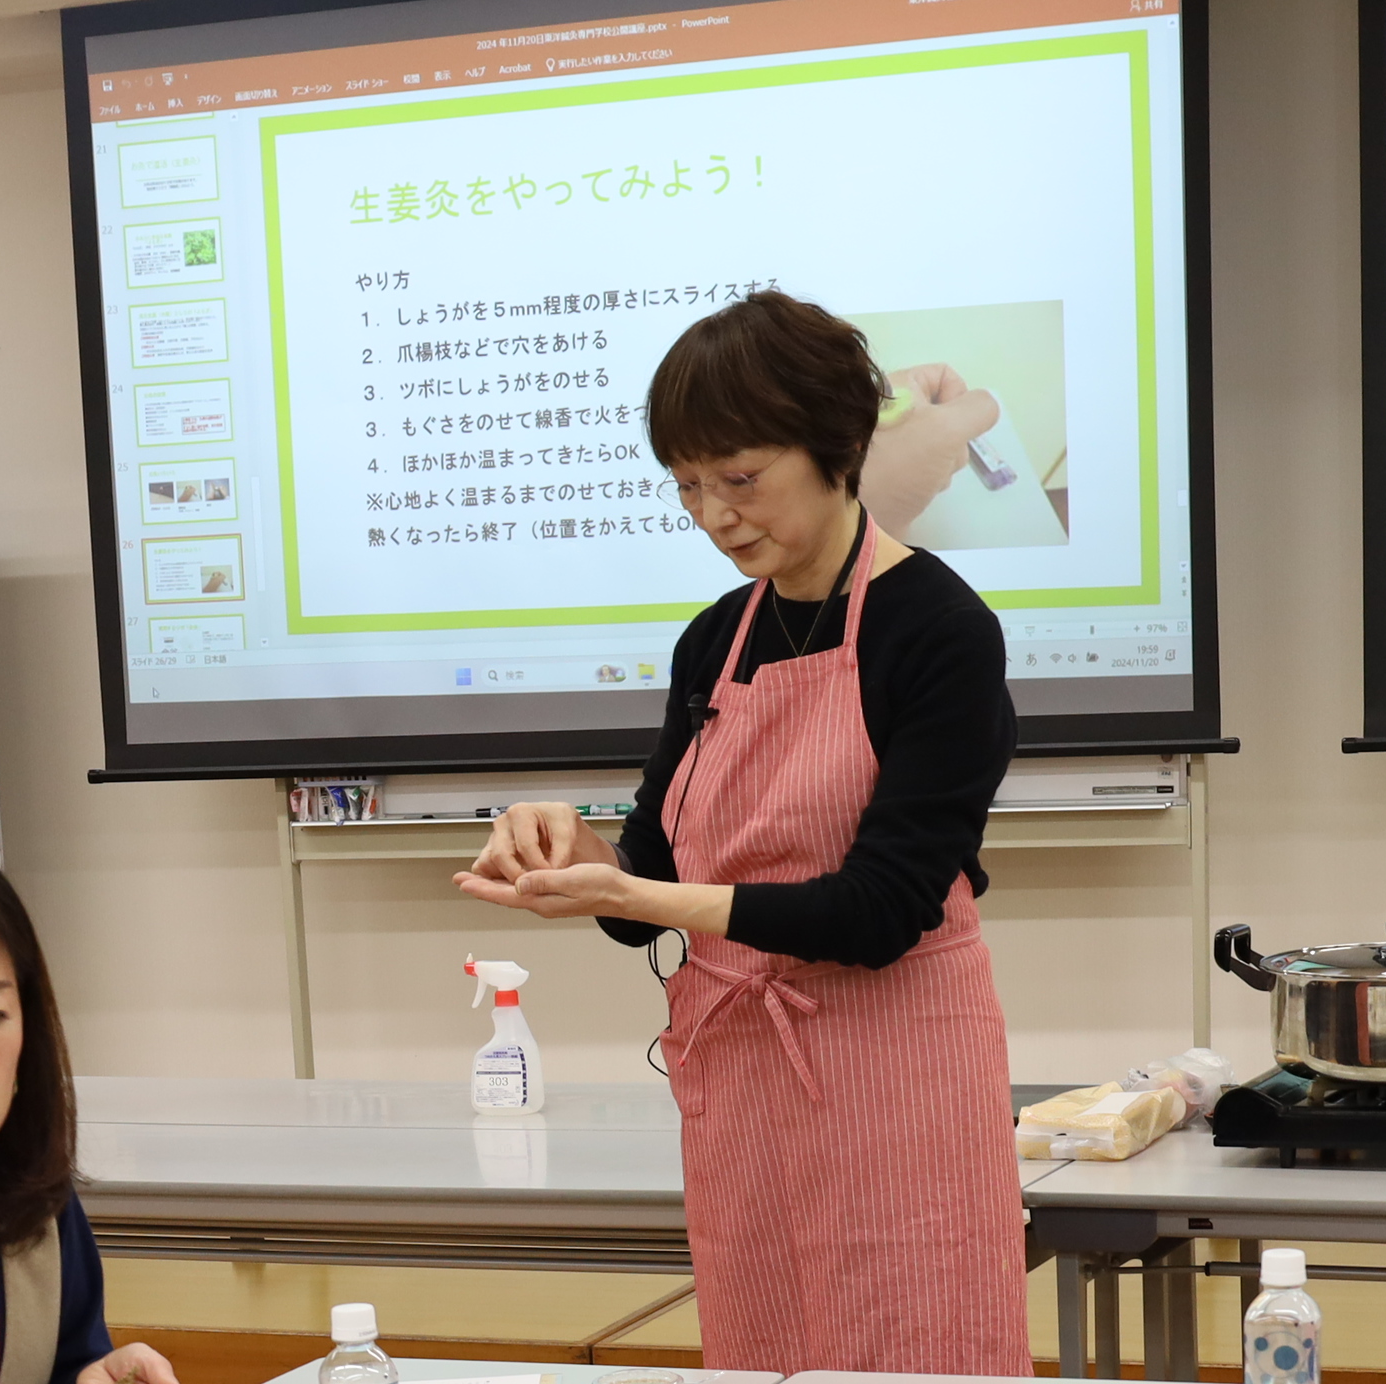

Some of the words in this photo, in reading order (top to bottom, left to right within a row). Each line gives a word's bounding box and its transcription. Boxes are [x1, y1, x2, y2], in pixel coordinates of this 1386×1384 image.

[476, 40, 497, 50] 2024
[682, 15, 729, 28] PowerPoint
[558, 49, 672, 69] 実行したい作業を入力してください
[99, 106, 121, 115] ファイル
[135, 102, 155, 112] ホーム
[168, 98, 183, 108] 挿入
[197, 94, 221, 105] デザイン
[235, 89, 277, 102] 画面切り替え
[292, 83, 332, 96] アニメーション
[434, 70, 451, 80] 表示
[465, 66, 486, 77] ヘルプ
[499, 63, 531, 73] Acrobat
[96, 145, 107, 154] 21
[350, 154, 763, 224] 生姜灸をやってみよう！
[102, 225, 113, 234] 22
[355, 269, 410, 292] やり方
[107, 305, 118, 314] 23
[397, 330, 608, 364] 爪楊枝などで穴をあける
[400, 368, 609, 399] ツボにしょうがをのせる
[112, 385, 123, 393] 24
[403, 444, 640, 472] ほかほか温まってきたらOK
[117, 463, 128, 472] 25
[123, 541, 133, 549] 26
[127, 617, 138, 626] 27
[1146, 624, 1167, 633] 97%
[1137, 646, 1159, 654] 19:59
[131, 656, 153, 666] スライド
[155, 657, 177, 665] 26/29
[204, 655, 227, 664] 日本語
[1026, 653, 1037, 666] あ
[1111, 658, 1159, 667] 2024/11/20
[489, 1077, 508, 1086] 303
